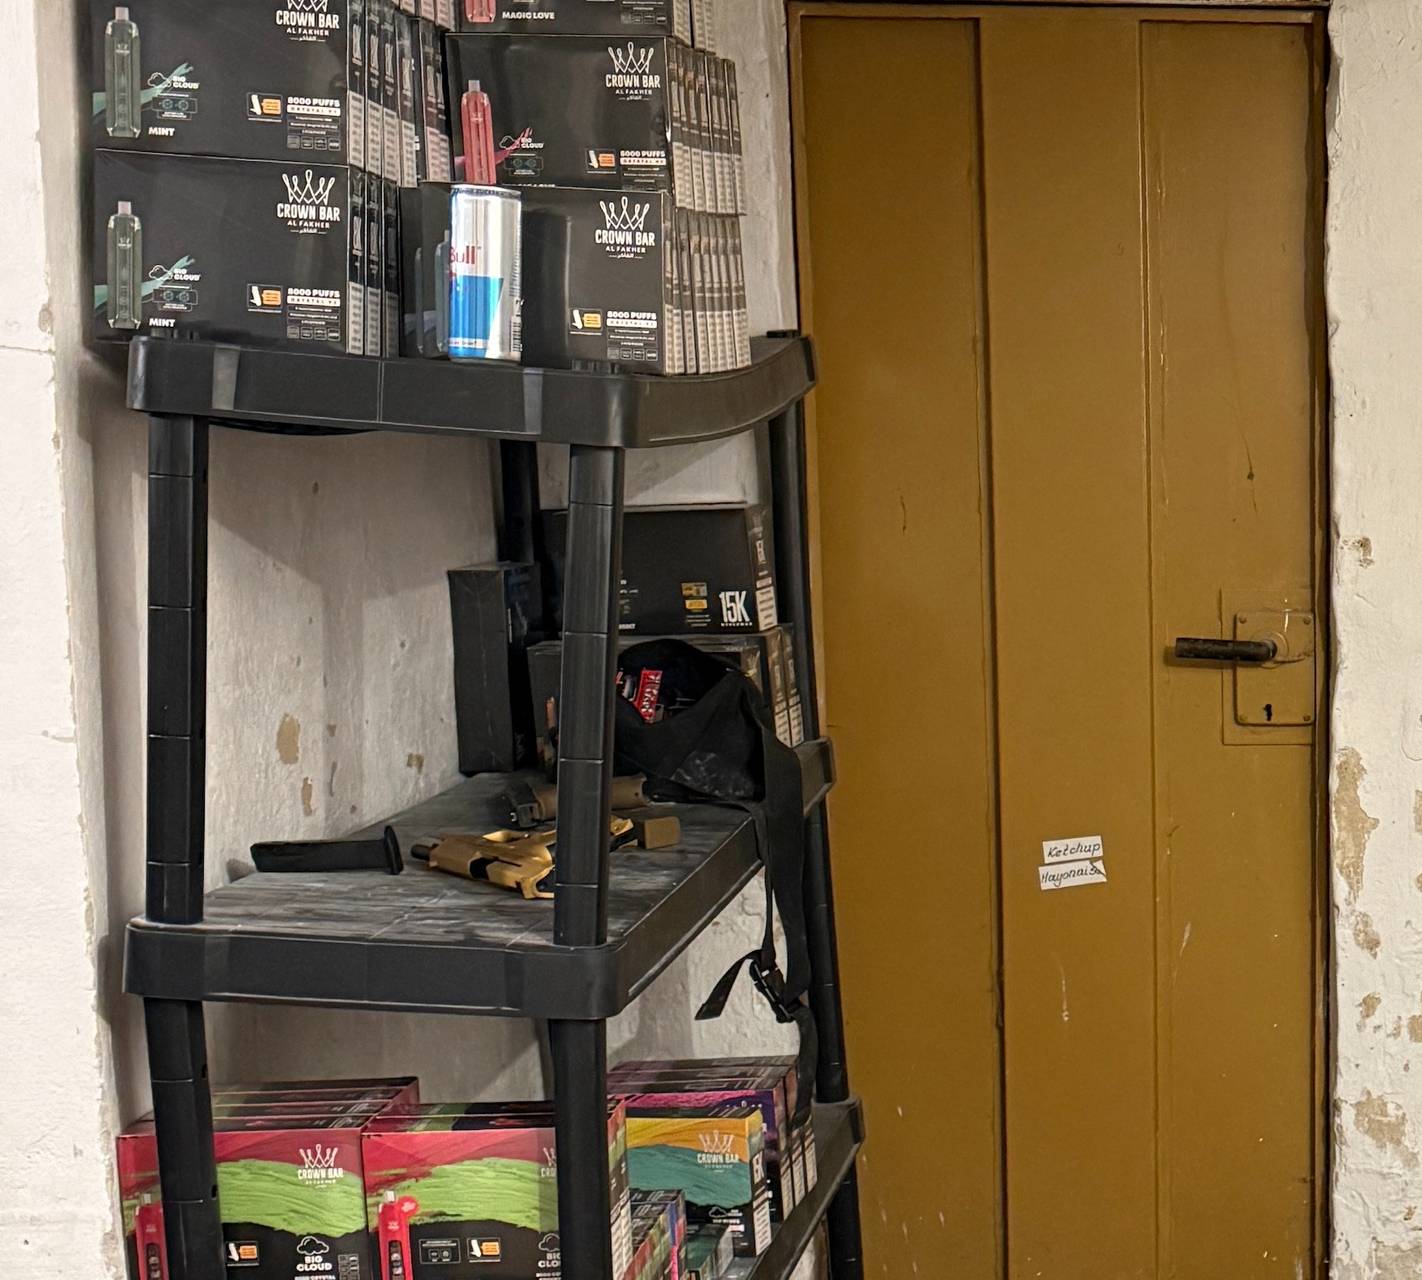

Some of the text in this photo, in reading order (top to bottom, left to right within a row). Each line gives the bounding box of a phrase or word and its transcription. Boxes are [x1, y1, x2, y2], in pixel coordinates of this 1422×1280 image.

[276, 10, 340, 29] CROWN BAR
[533, 12, 555, 20] LOVE
[605, 74, 661, 88] CROWN BAR
[148, 127, 175, 136] MINT
[277, 203, 340, 221] CROWN BAR
[595, 229, 655, 246] CROWN BAR
[149, 318, 176, 327] MINT
[719, 591, 750, 622] 15K
[1048, 842, 1101, 857] Ketchup
[297, 1168, 326, 1180] CROWN
[304, 1255, 323, 1264] BIG
[296, 1262, 333, 1272] CLOUD
